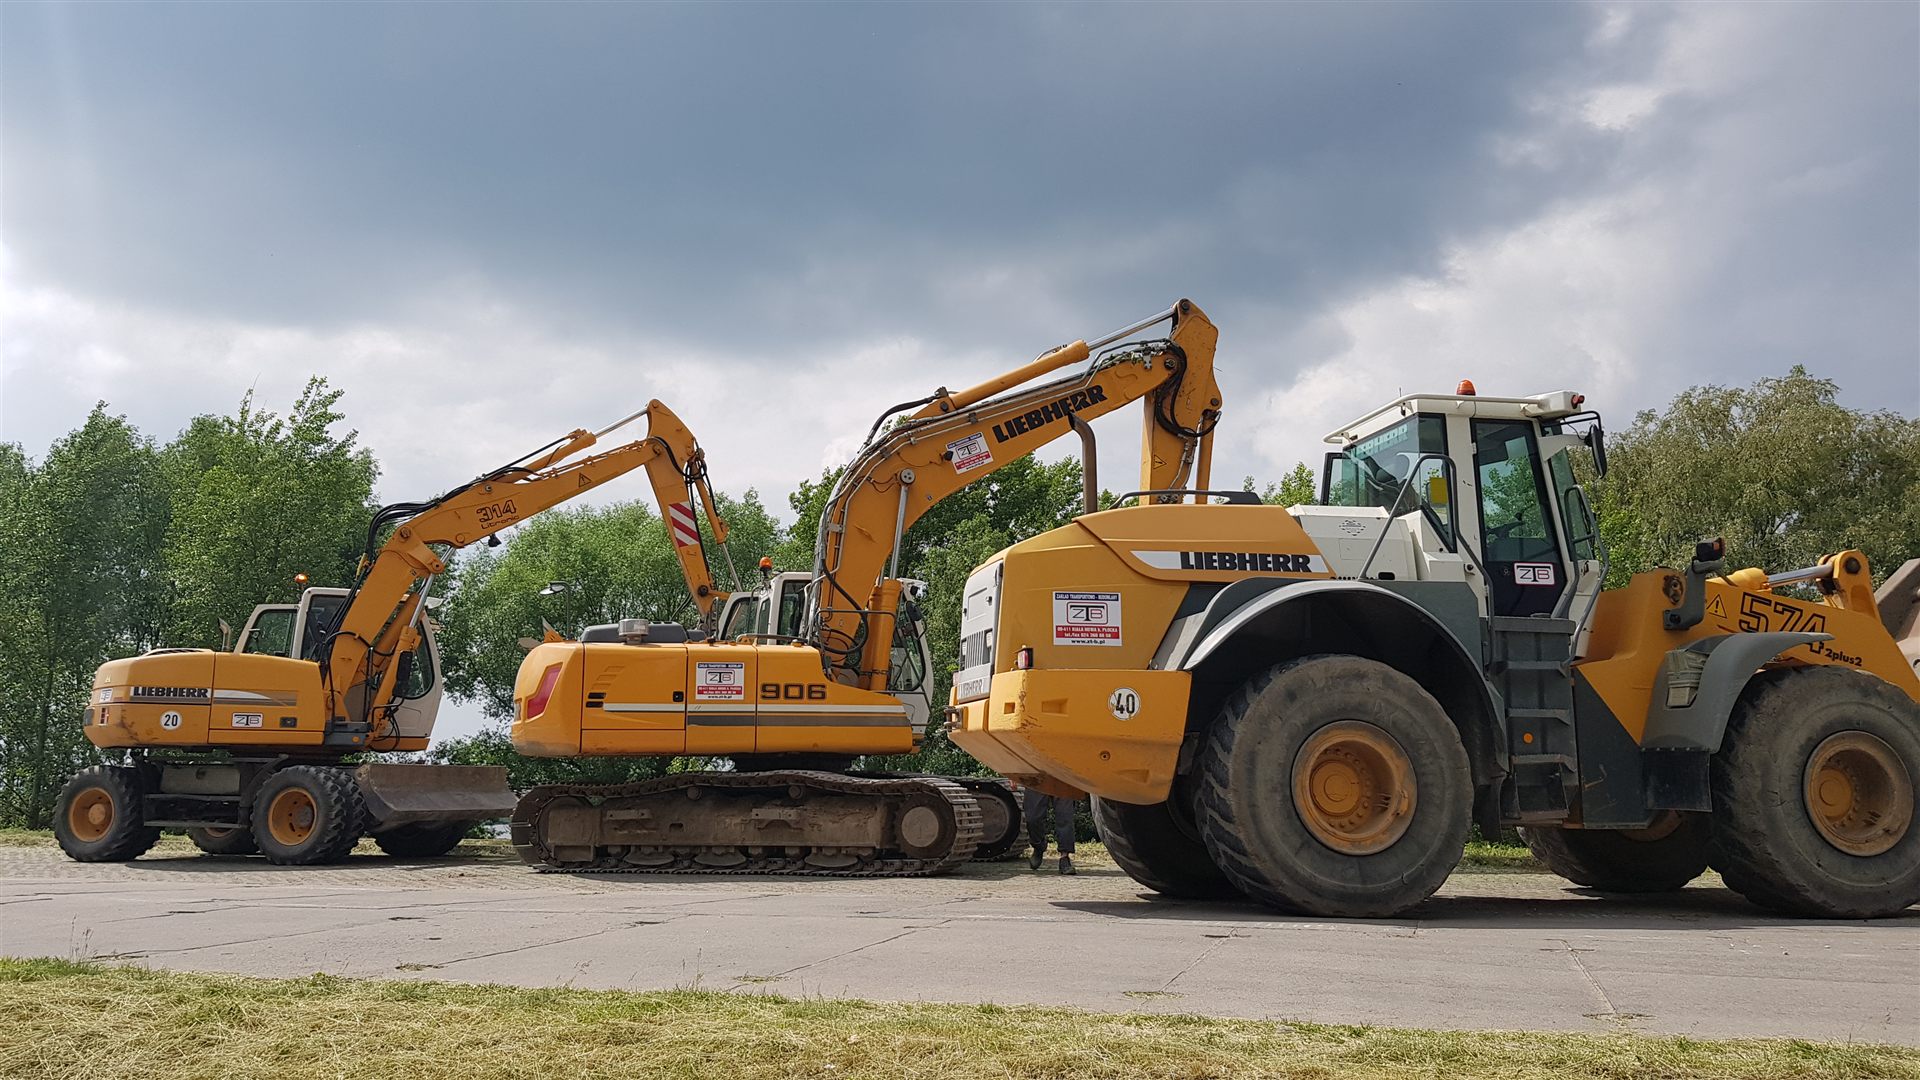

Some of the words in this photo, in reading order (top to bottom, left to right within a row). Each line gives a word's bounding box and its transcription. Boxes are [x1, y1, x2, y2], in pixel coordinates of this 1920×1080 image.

[992, 384, 1108, 443] LIEBHERR
[476, 499, 517, 522] 314
[1180, 552, 1312, 573] LIEBHERR
[1738, 591, 1826, 654] 574
[1824, 648, 1863, 667] 2plus2
[133, 686, 209, 698] LIEBHERR
[761, 683, 826, 700] 906
[1115, 692, 1135, 715] 40
[163, 713, 178, 727] 20
